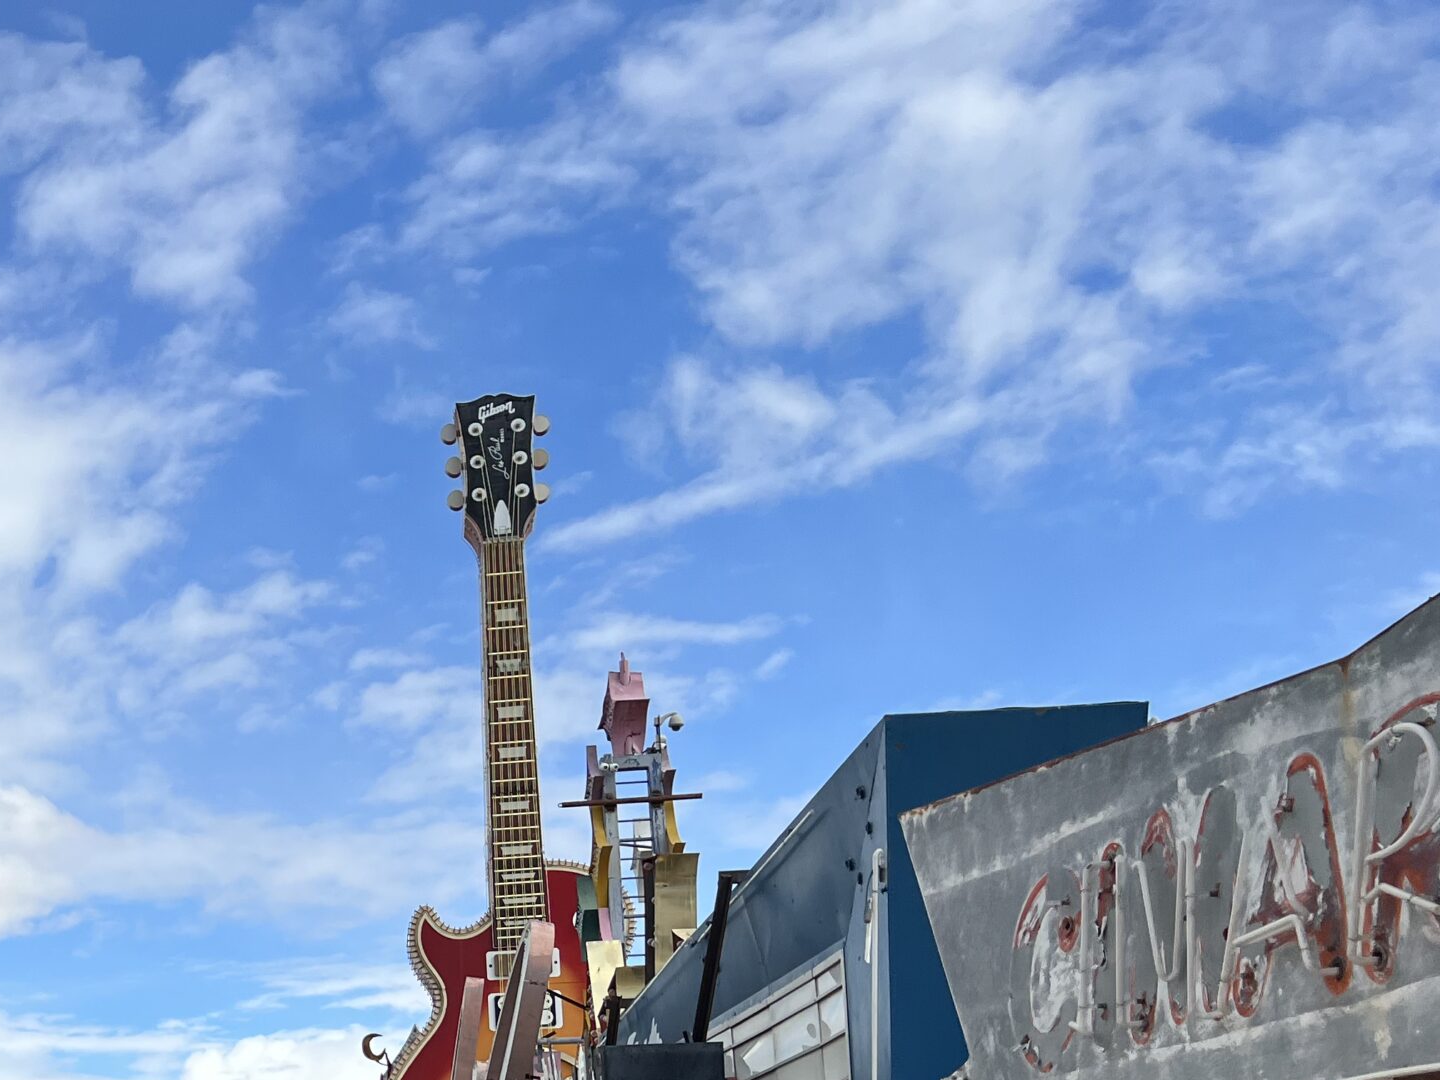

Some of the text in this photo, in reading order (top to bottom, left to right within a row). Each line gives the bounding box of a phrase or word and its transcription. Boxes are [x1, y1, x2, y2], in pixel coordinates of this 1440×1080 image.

[478, 401, 516, 424] Gibson
[487, 437, 510, 480] Les Paul
